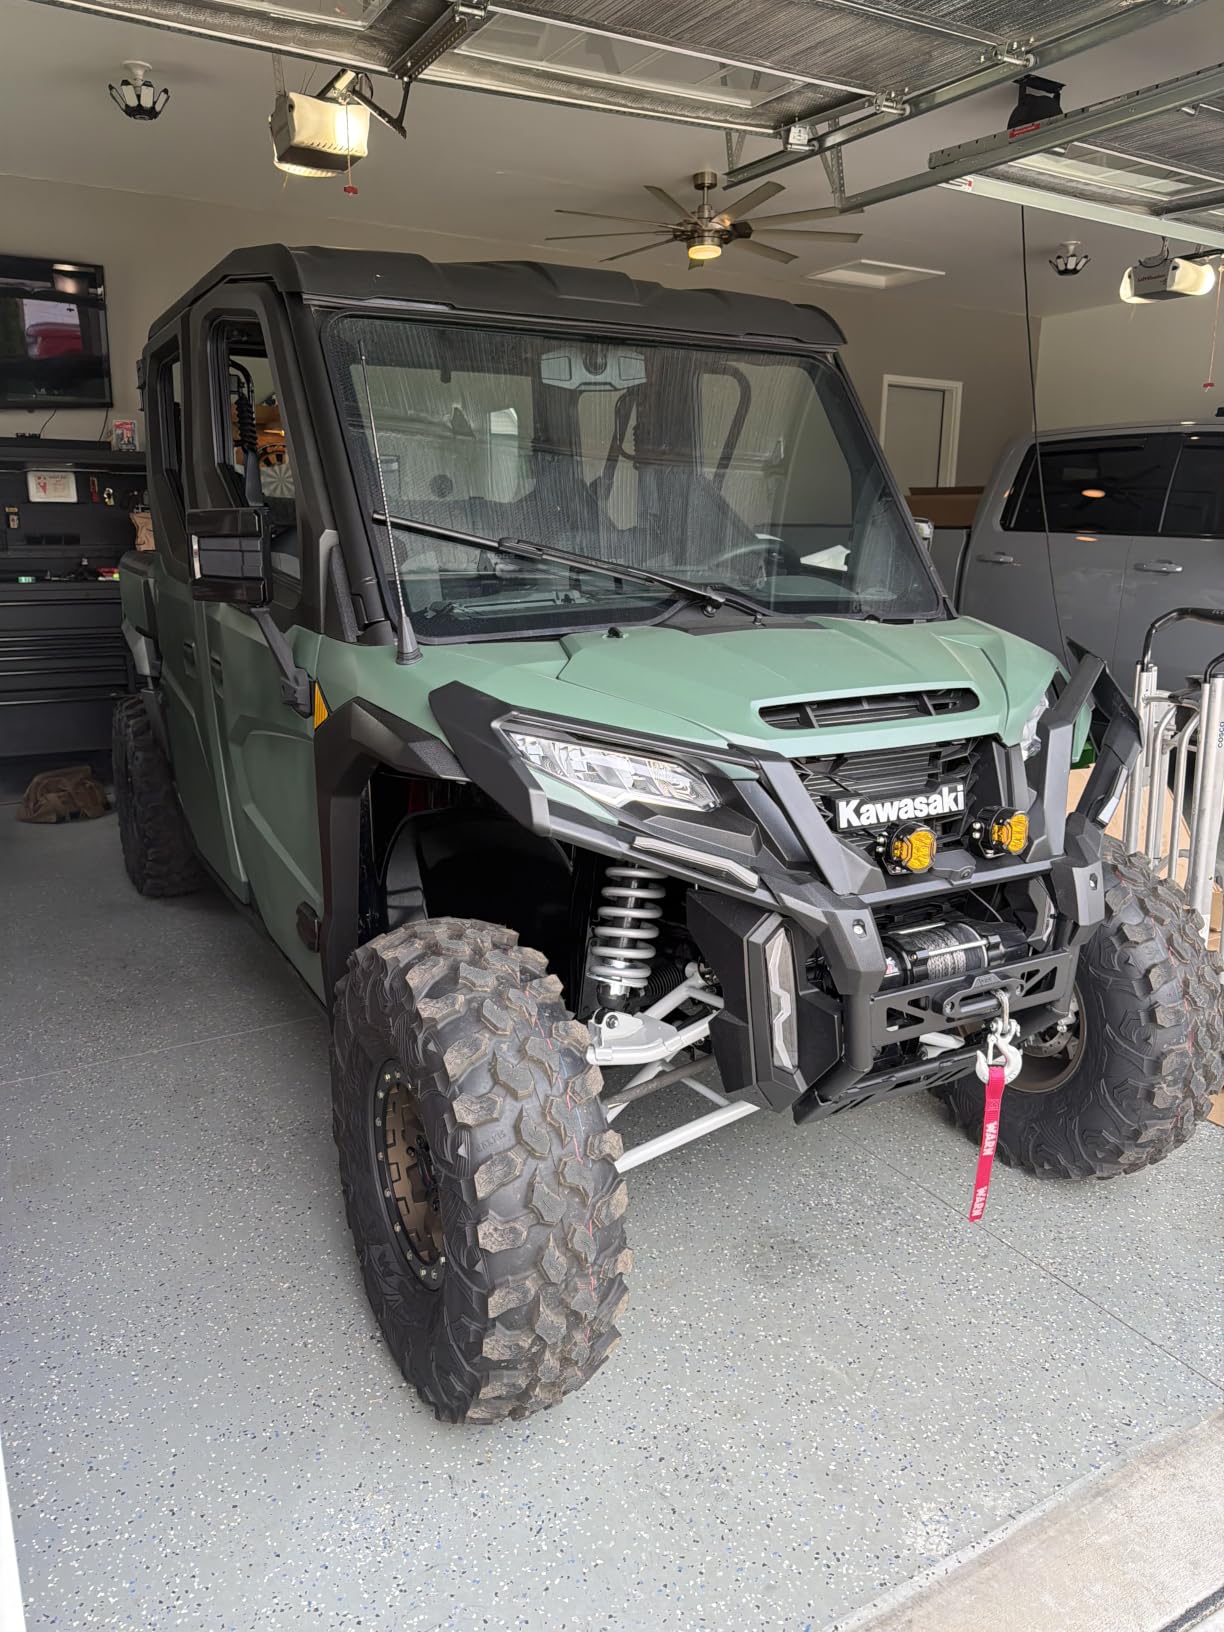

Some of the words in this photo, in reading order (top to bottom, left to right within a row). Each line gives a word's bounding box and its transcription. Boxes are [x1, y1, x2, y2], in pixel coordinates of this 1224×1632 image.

[838, 784, 965, 829] Kawasaki
[983, 1121, 998, 1156] WARN
[972, 1186, 988, 1216] WARN
